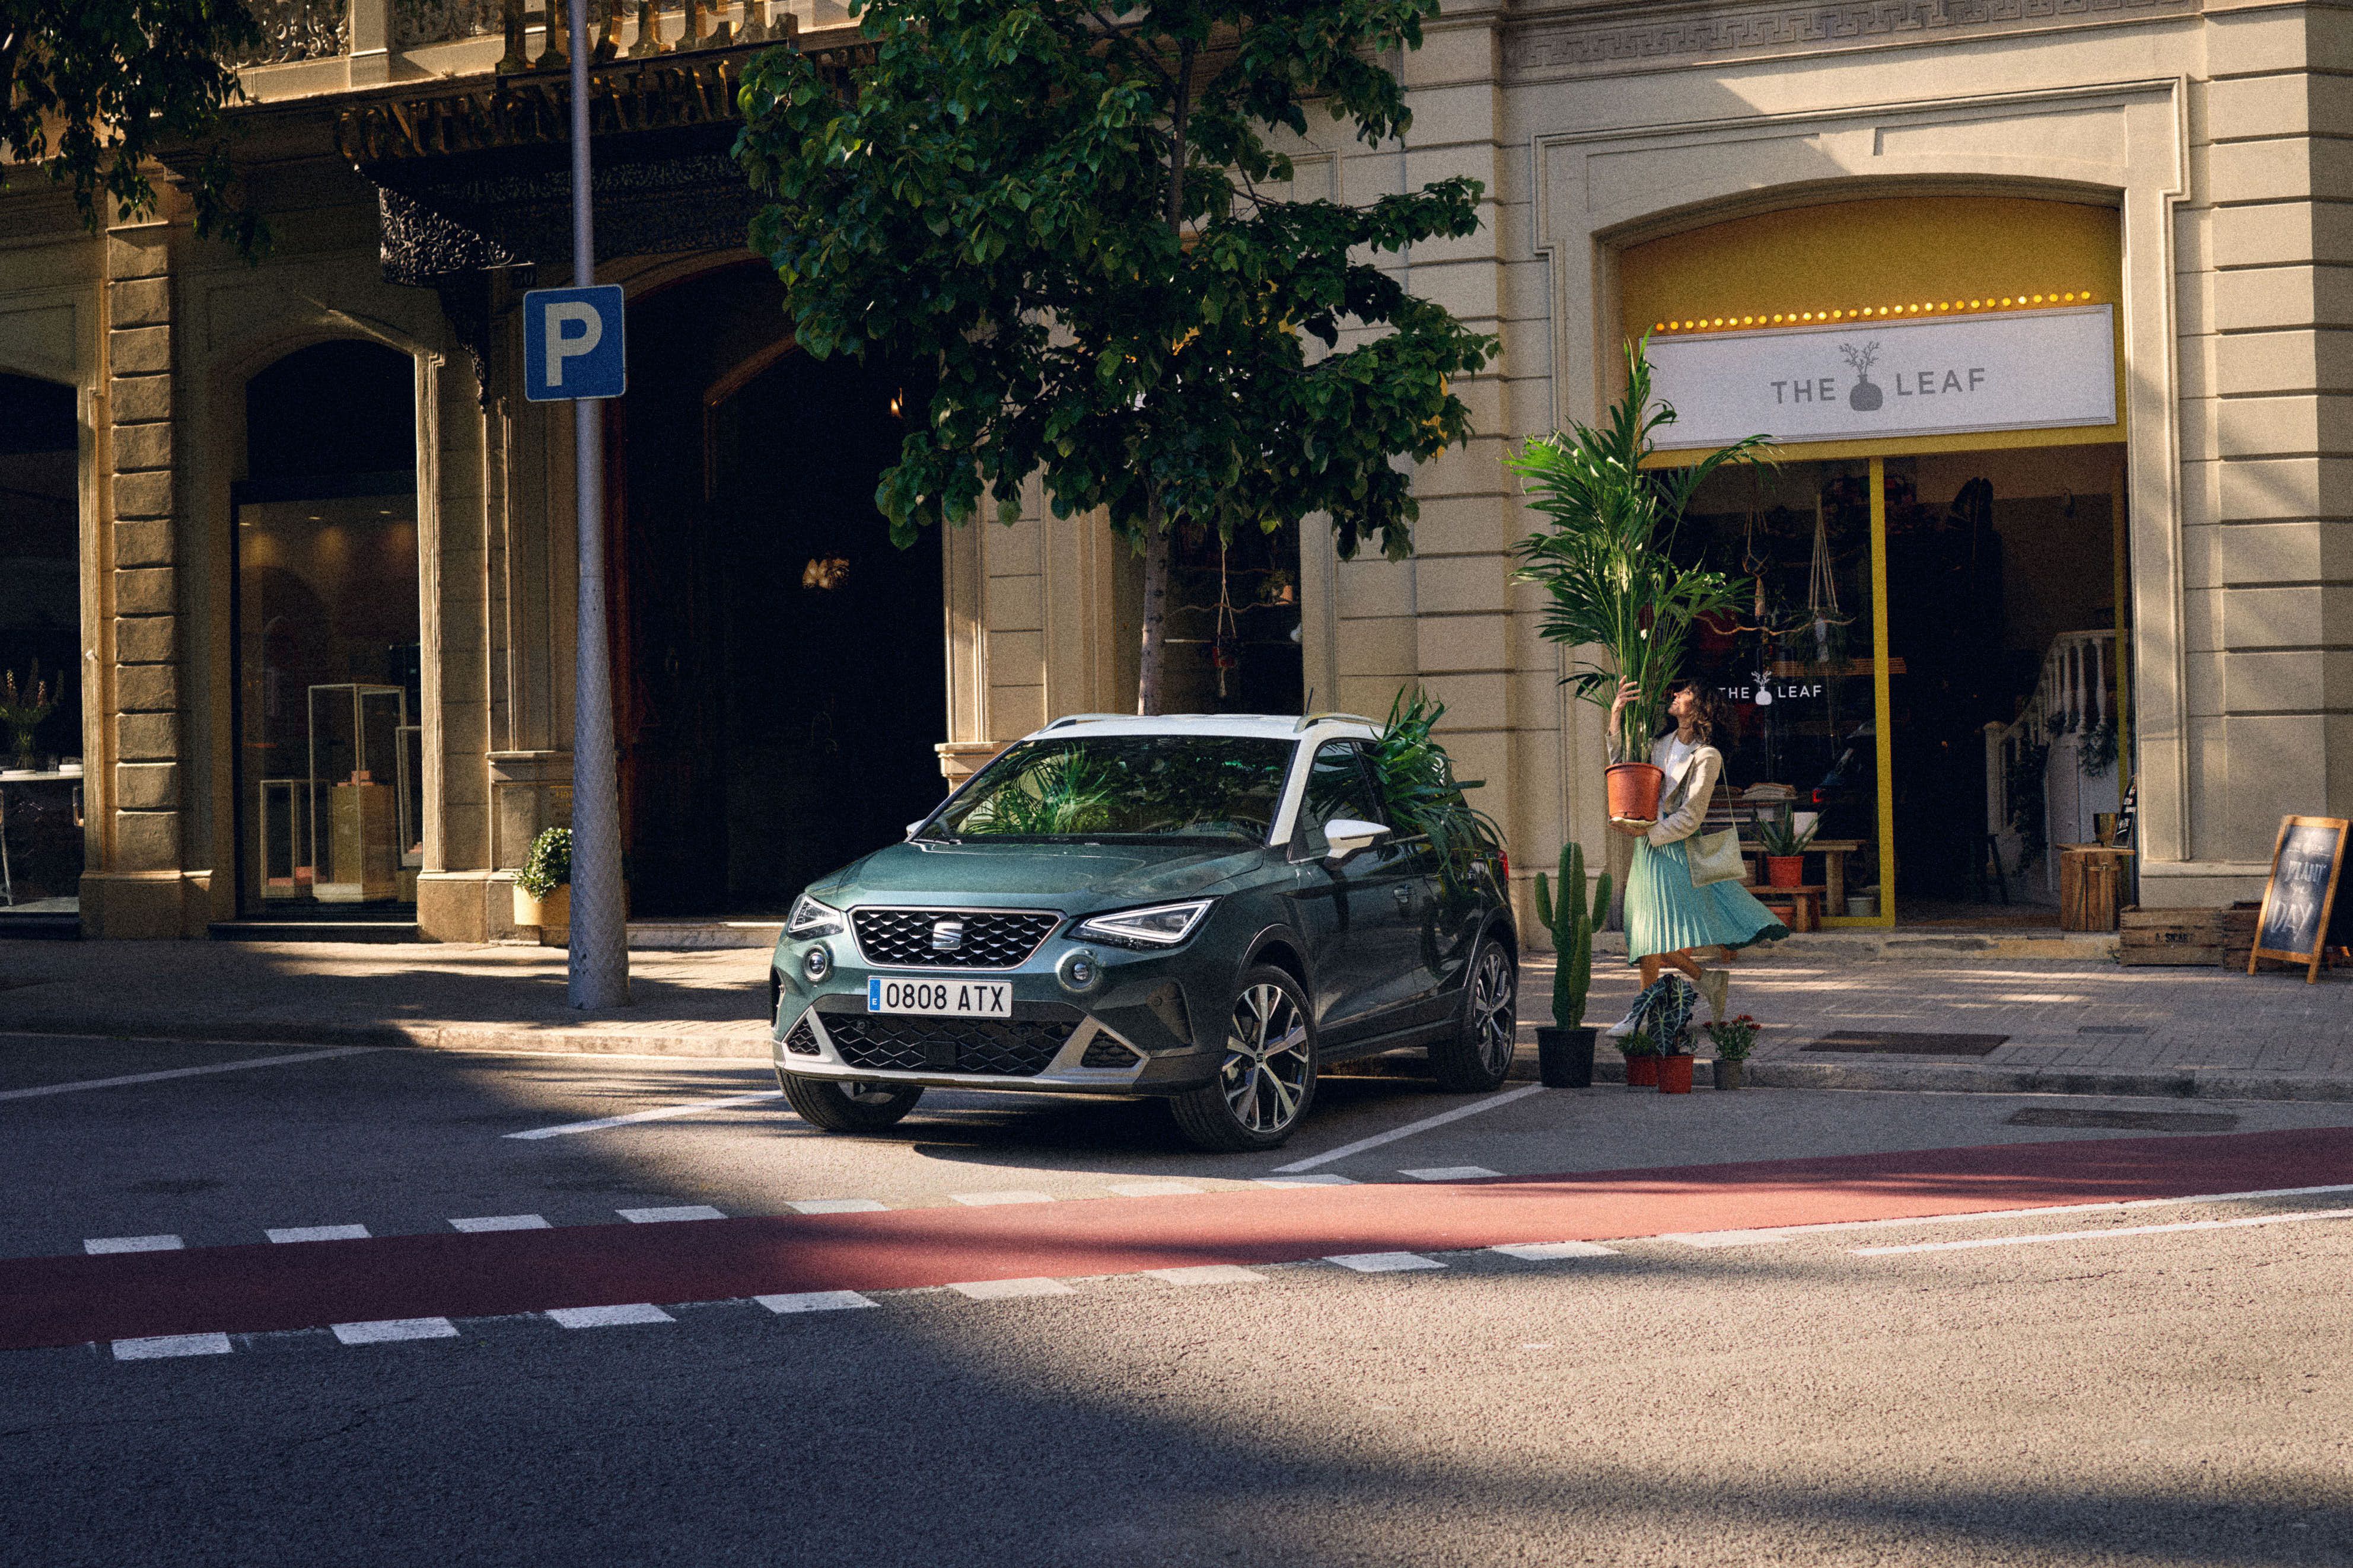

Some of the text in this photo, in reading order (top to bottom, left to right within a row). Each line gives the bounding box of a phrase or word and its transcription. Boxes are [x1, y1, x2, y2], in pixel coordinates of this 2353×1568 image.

[545, 301, 603, 387] P
[1771, 367, 1986, 405] THE LEAF
[1778, 685, 1822, 698] LEAF
[2270, 900, 2313, 942] DAY
[886, 983, 1004, 1012] 0808 ATX
